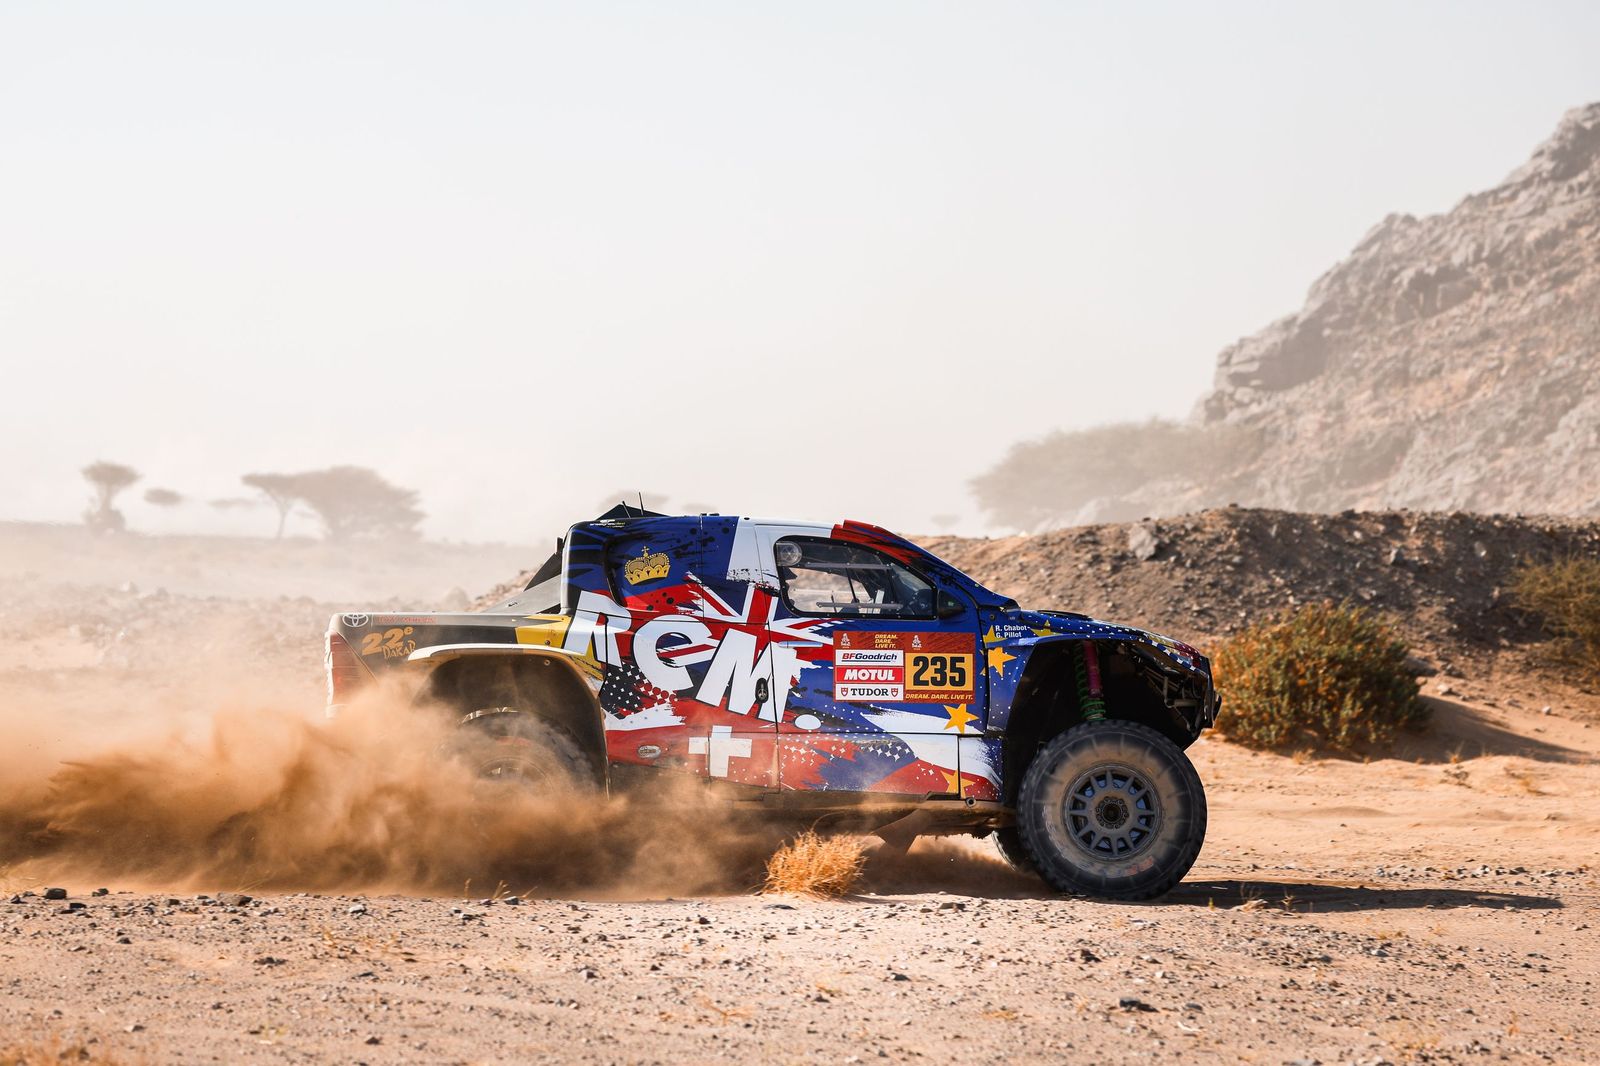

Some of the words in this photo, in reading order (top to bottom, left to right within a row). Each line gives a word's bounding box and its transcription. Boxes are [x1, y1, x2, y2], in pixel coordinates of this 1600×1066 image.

[844, 669, 896, 681] MOTUL
[913, 655, 966, 687] 235
[850, 688, 889, 697] TUDOR
